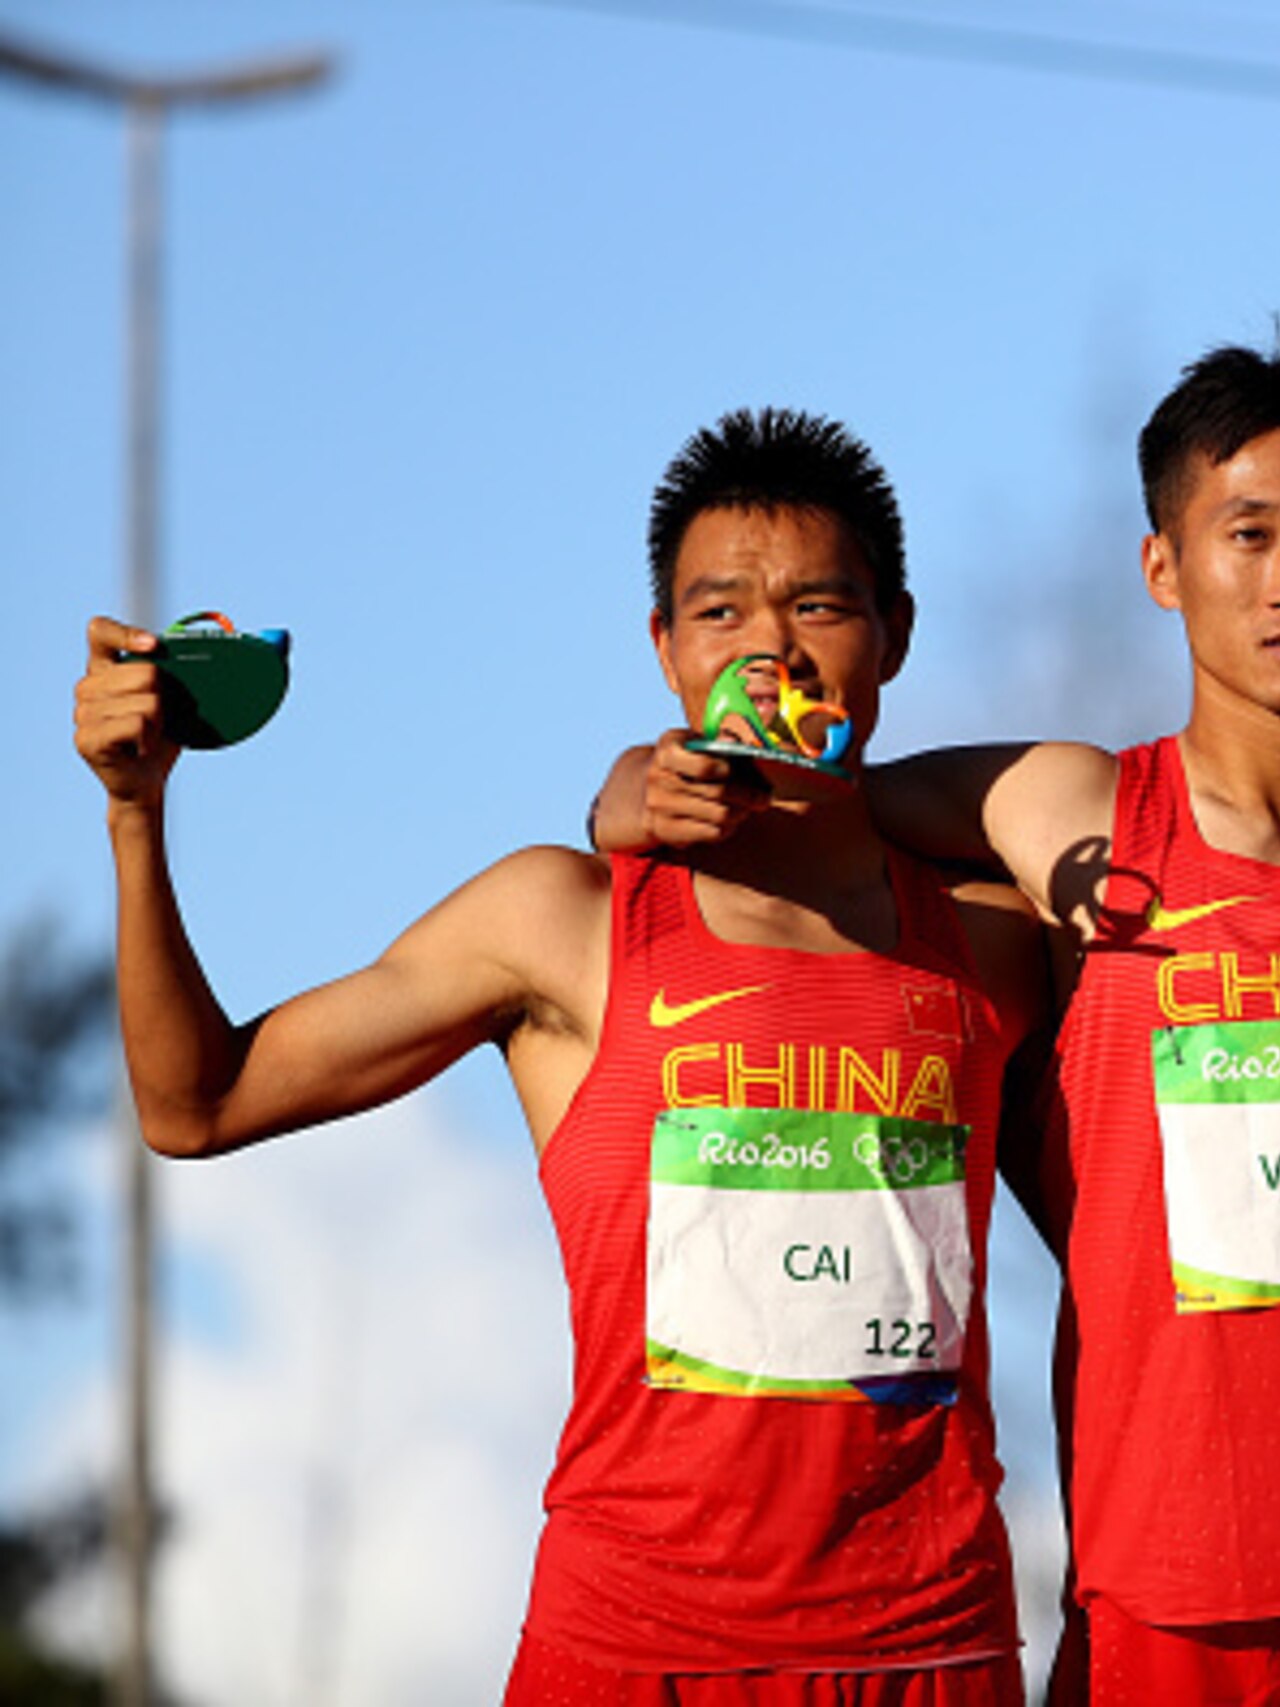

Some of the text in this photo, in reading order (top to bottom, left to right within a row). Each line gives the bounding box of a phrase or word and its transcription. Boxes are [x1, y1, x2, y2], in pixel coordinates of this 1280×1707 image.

[664, 1043, 956, 1124] CHINA
[783, 1245, 851, 1283] CAI
[865, 1318, 937, 1359] 122
